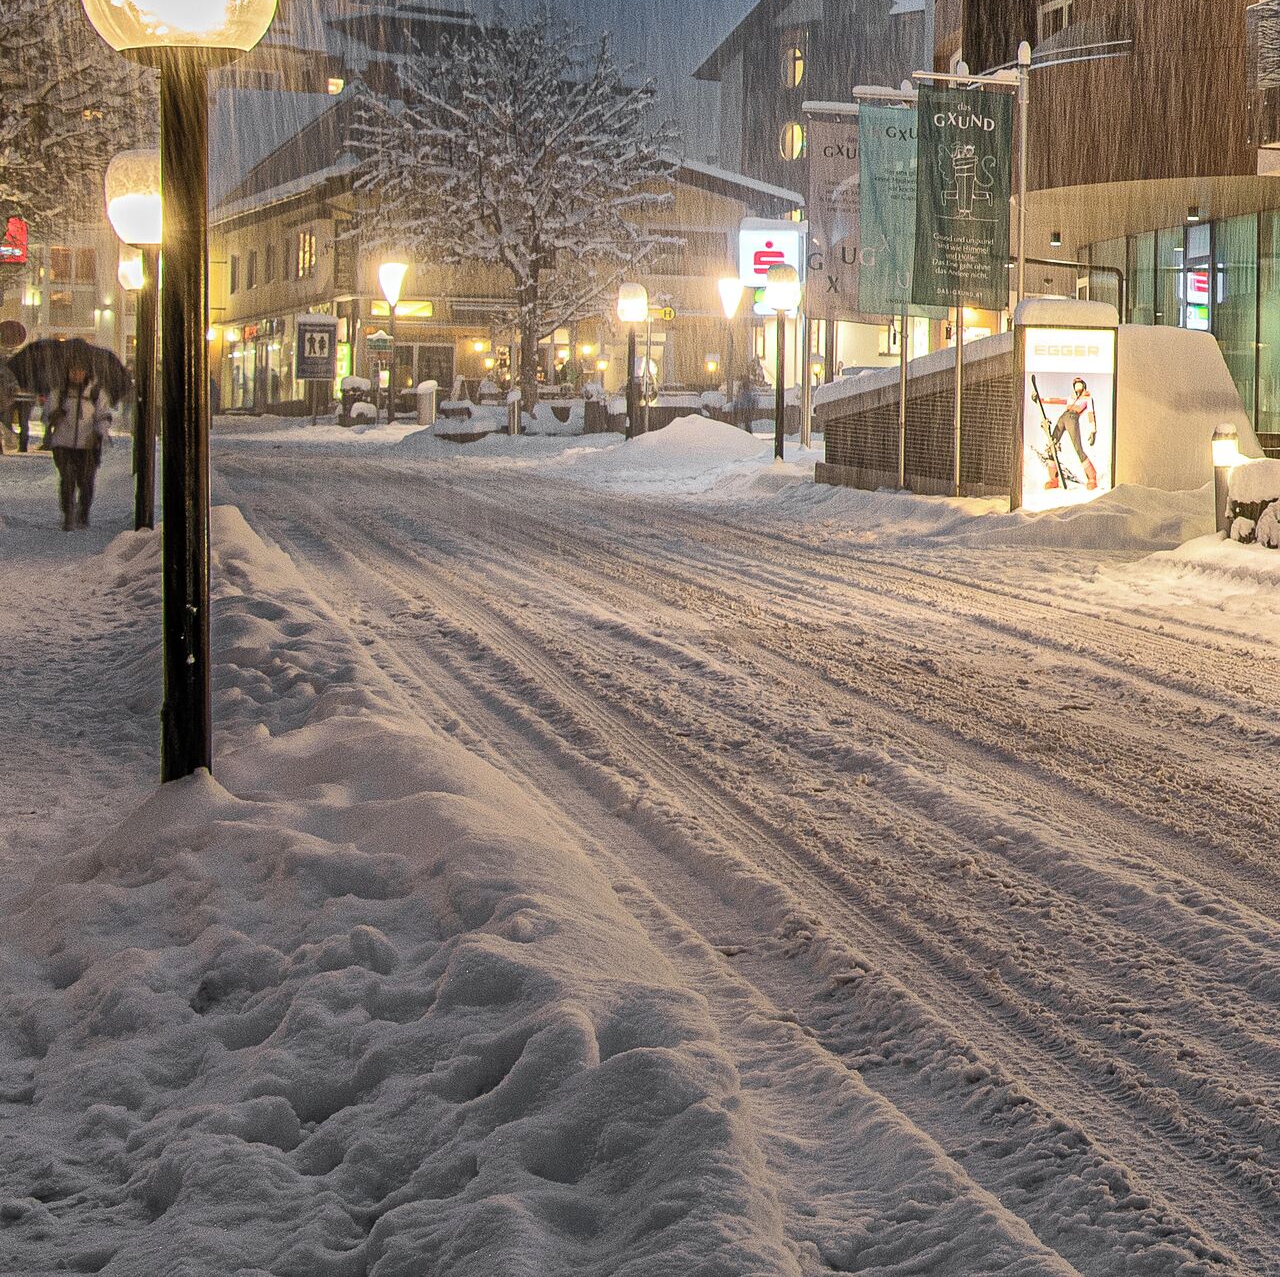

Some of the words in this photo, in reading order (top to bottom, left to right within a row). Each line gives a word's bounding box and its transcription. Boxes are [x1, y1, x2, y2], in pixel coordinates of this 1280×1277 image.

[957, 102, 972, 111] das
[934, 112, 995, 131] GXUND
[1034, 345, 1100, 356] EGGER
